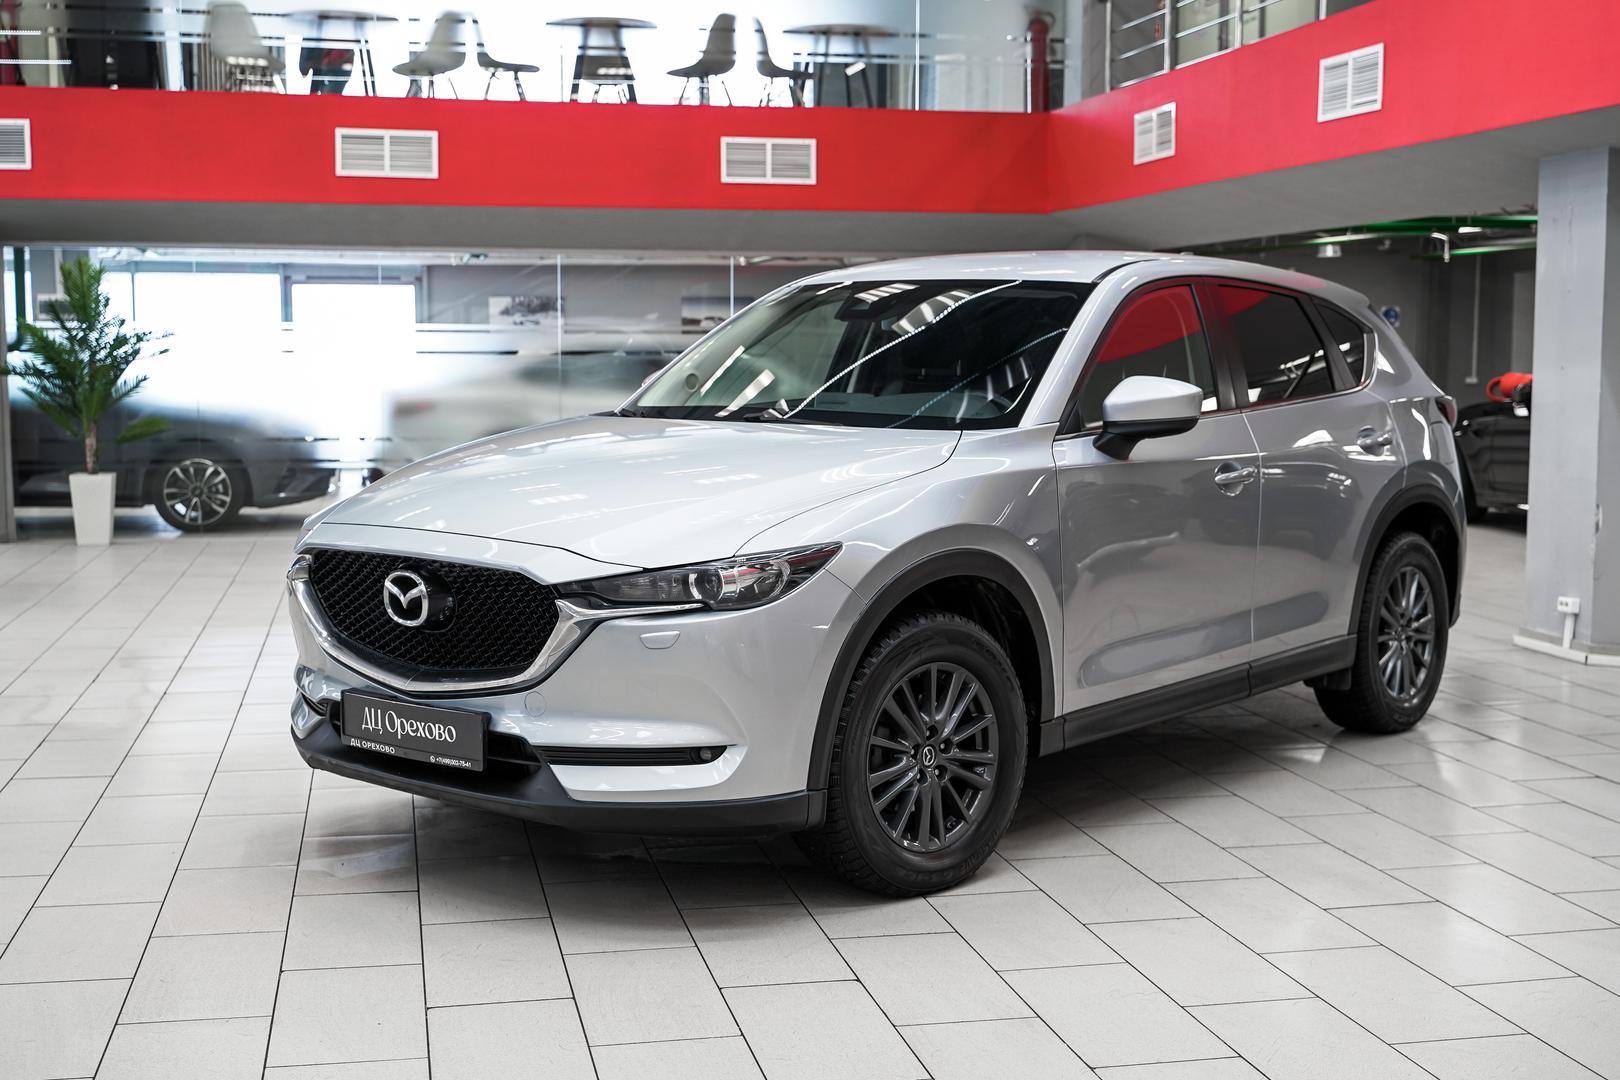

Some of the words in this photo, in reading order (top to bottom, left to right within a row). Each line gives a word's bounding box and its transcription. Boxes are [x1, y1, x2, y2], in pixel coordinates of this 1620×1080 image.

[362, 706, 383, 734] ДЦ
[385, 710, 456, 743] Орехово
[350, 738, 361, 748] ДЦ
[361, 740, 396, 754] ОРЕХОВО
